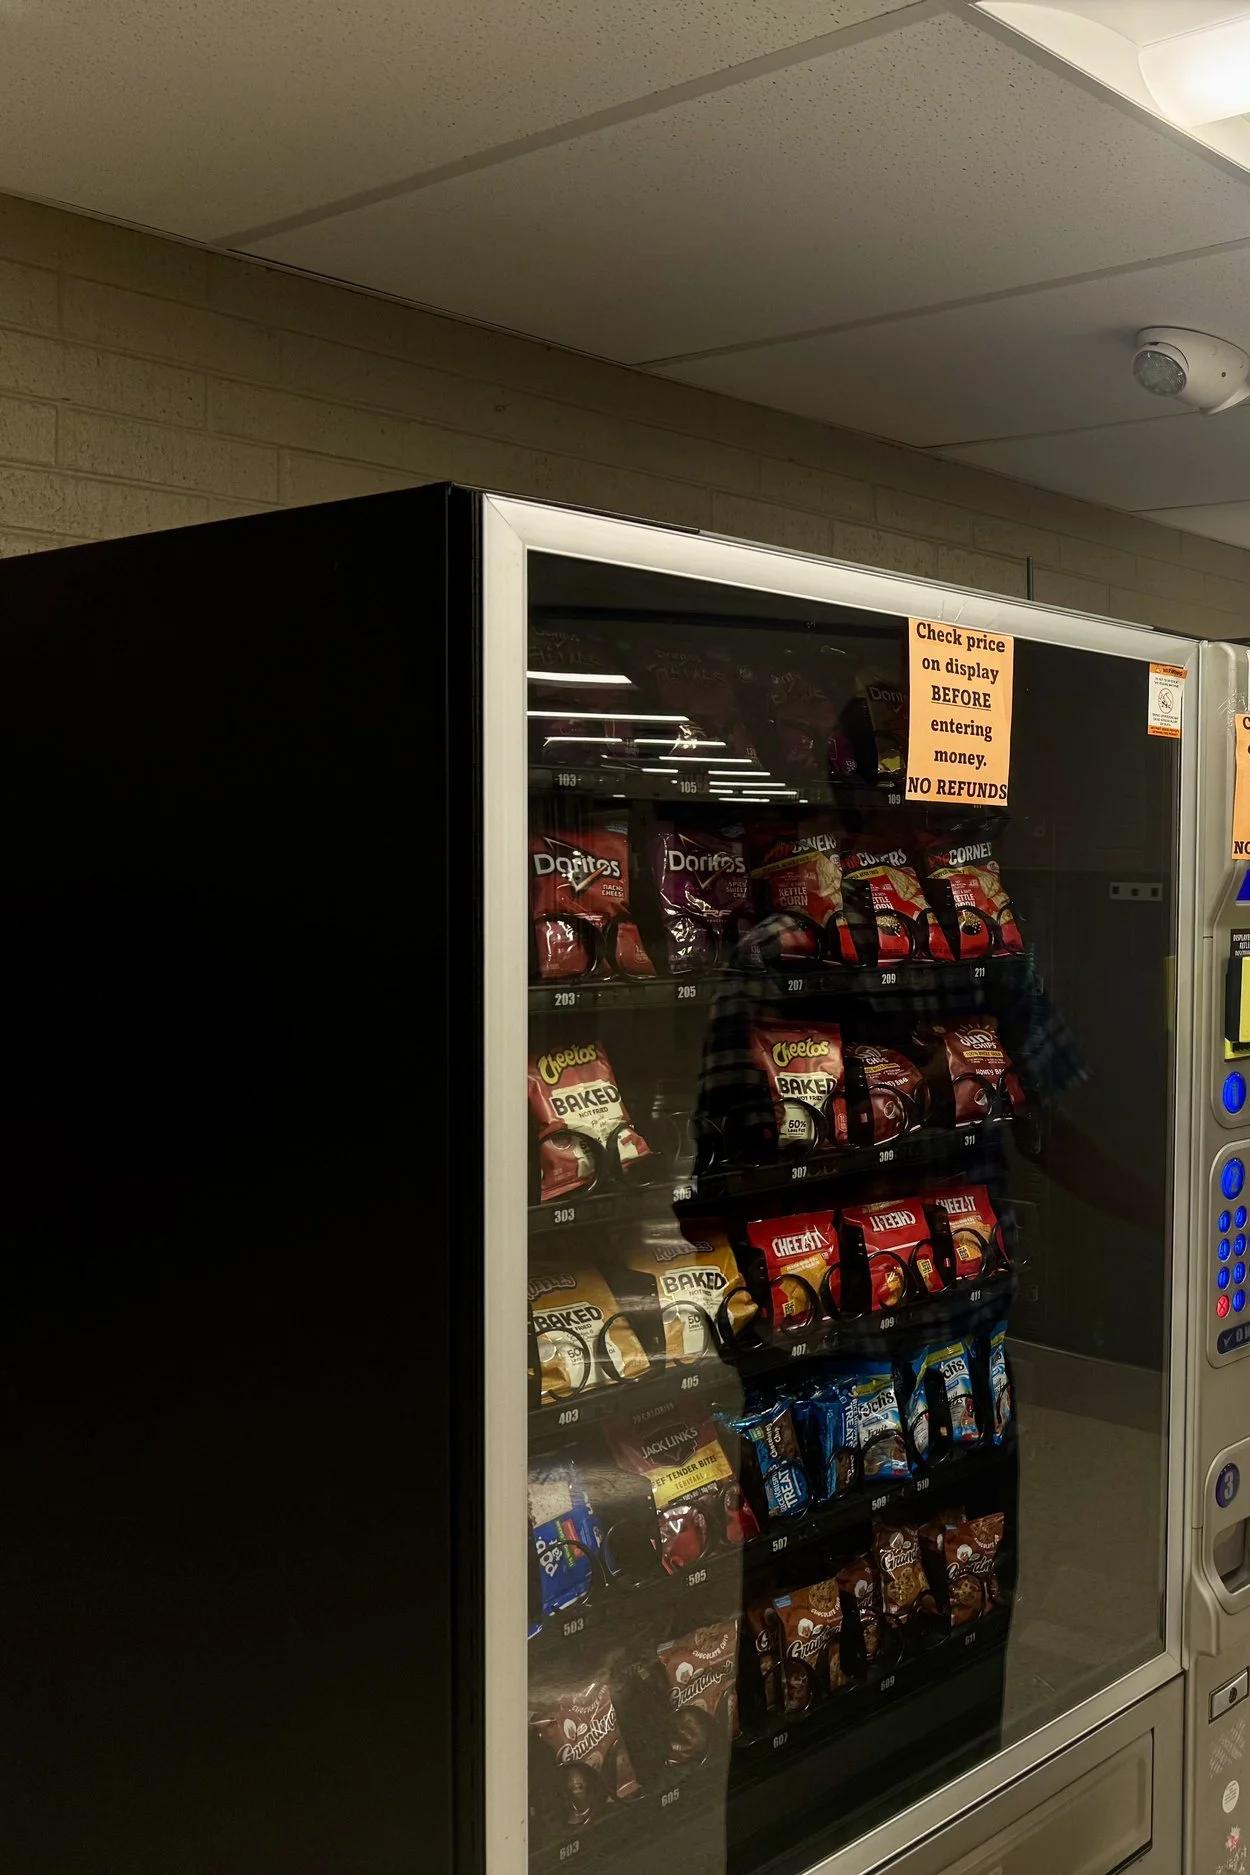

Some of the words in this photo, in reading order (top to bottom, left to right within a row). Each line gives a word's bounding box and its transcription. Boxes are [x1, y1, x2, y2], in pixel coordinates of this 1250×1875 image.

[916, 622, 963, 648] Check
[966, 634, 1006, 657] price
[922, 657, 941, 672] on
[945, 657, 1000, 685] display
[931, 684, 992, 709] BEFORE
[931, 718, 993, 743] entering
[934, 749, 988, 771] money.
[558, 773, 577, 787] 103
[680, 782, 697, 794] 105
[908, 777, 932, 795] NO
[936, 779, 1008, 801] REFUNDS
[888, 794, 901, 806] 109
[533, 853, 621, 878] Doritos
[668, 850, 746, 874] Doritos
[778, 886, 807, 898] KETTLE
[780, 895, 808, 907] CORN
[872, 896, 891, 905] ETTLE
[881, 973, 897, 985] 209
[974, 967, 986, 978] 211
[677, 985, 697, 998] 205
[788, 979, 803, 991] 207
[555, 992, 576, 1006] 203
[772, 1036, 830, 1069] Cheetos
[537, 1043, 598, 1086] Cheetos
[777, 1078, 837, 1096] BAKED
[551, 1084, 621, 1117] BAKED
[579, 1111, 592, 1119] NOT
[592, 1106, 609, 1115] FRIED
[788, 1119, 807, 1129] 50%
[964, 1135, 976, 1146] 311
[879, 1150, 894, 1163] 309
[792, 1166, 807, 1179] 307
[1230, 1166, 1240, 1194] 2
[673, 1186, 692, 1202] 305
[554, 1208, 575, 1223] 303
[1235, 1211, 1243, 1224] 2
[1235, 1238, 1244, 1251] 5
[663, 1272, 728, 1295] BAKED
[970, 1290, 981, 1302] 411
[534, 1306, 603, 1330] BAKED
[688, 1315, 701, 1325] 50
[879, 1317, 895, 1330] 409
[567, 1348, 581, 1359] 50
[791, 1344, 807, 1357] 407
[943, 1360, 965, 1379] ch's
[681, 1375, 699, 1390] 405
[559, 1408, 579, 1425] 403
[641, 1442, 669, 1460] JACK
[667, 1463, 700, 1483] TENDER
[699, 1454, 718, 1469] BITES
[675, 1473, 706, 1491] TERIYAKI
[916, 1477, 930, 1492] 510
[1223, 1470, 1235, 1500] 3
[871, 1495, 887, 1511] 509
[772, 1536, 788, 1552] 507
[880, 1542, 920, 1572] Grand
[688, 1569, 706, 1586] 505
[563, 1618, 584, 1636] 503
[965, 1631, 977, 1646] 611
[692, 1648, 722, 1660] CHOCOLATE
[880, 1675, 895, 1692] 609
[772, 1732, 788, 1749] 607
[661, 1789, 680, 1807] 605
[559, 1840, 580, 1860] 603
